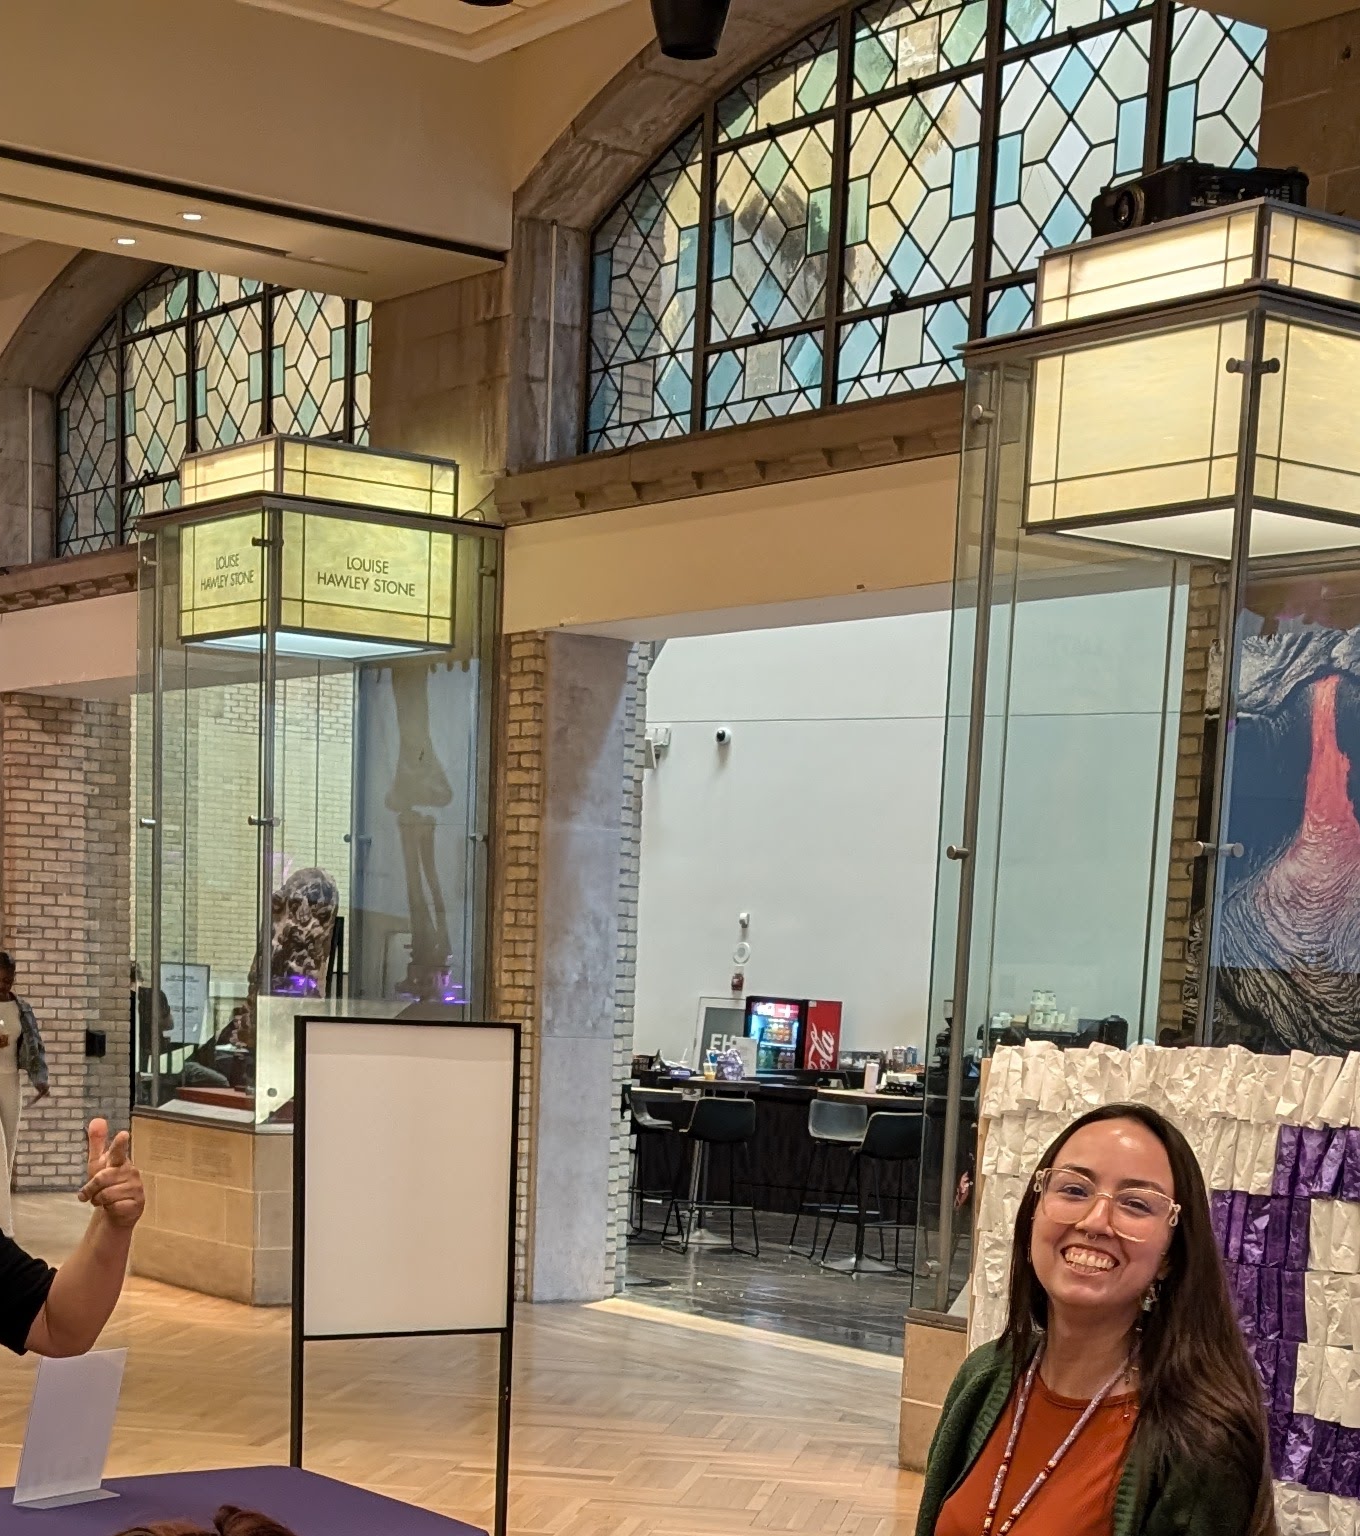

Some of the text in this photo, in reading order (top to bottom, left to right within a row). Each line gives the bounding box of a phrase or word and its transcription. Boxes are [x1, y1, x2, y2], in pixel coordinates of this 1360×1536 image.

[215, 553, 240, 570] LOUISE
[346, 555, 389, 575] LOUISE
[200, 570, 254, 591] HAWLEY STONE
[317, 571, 416, 597] HAWLEY STONE
